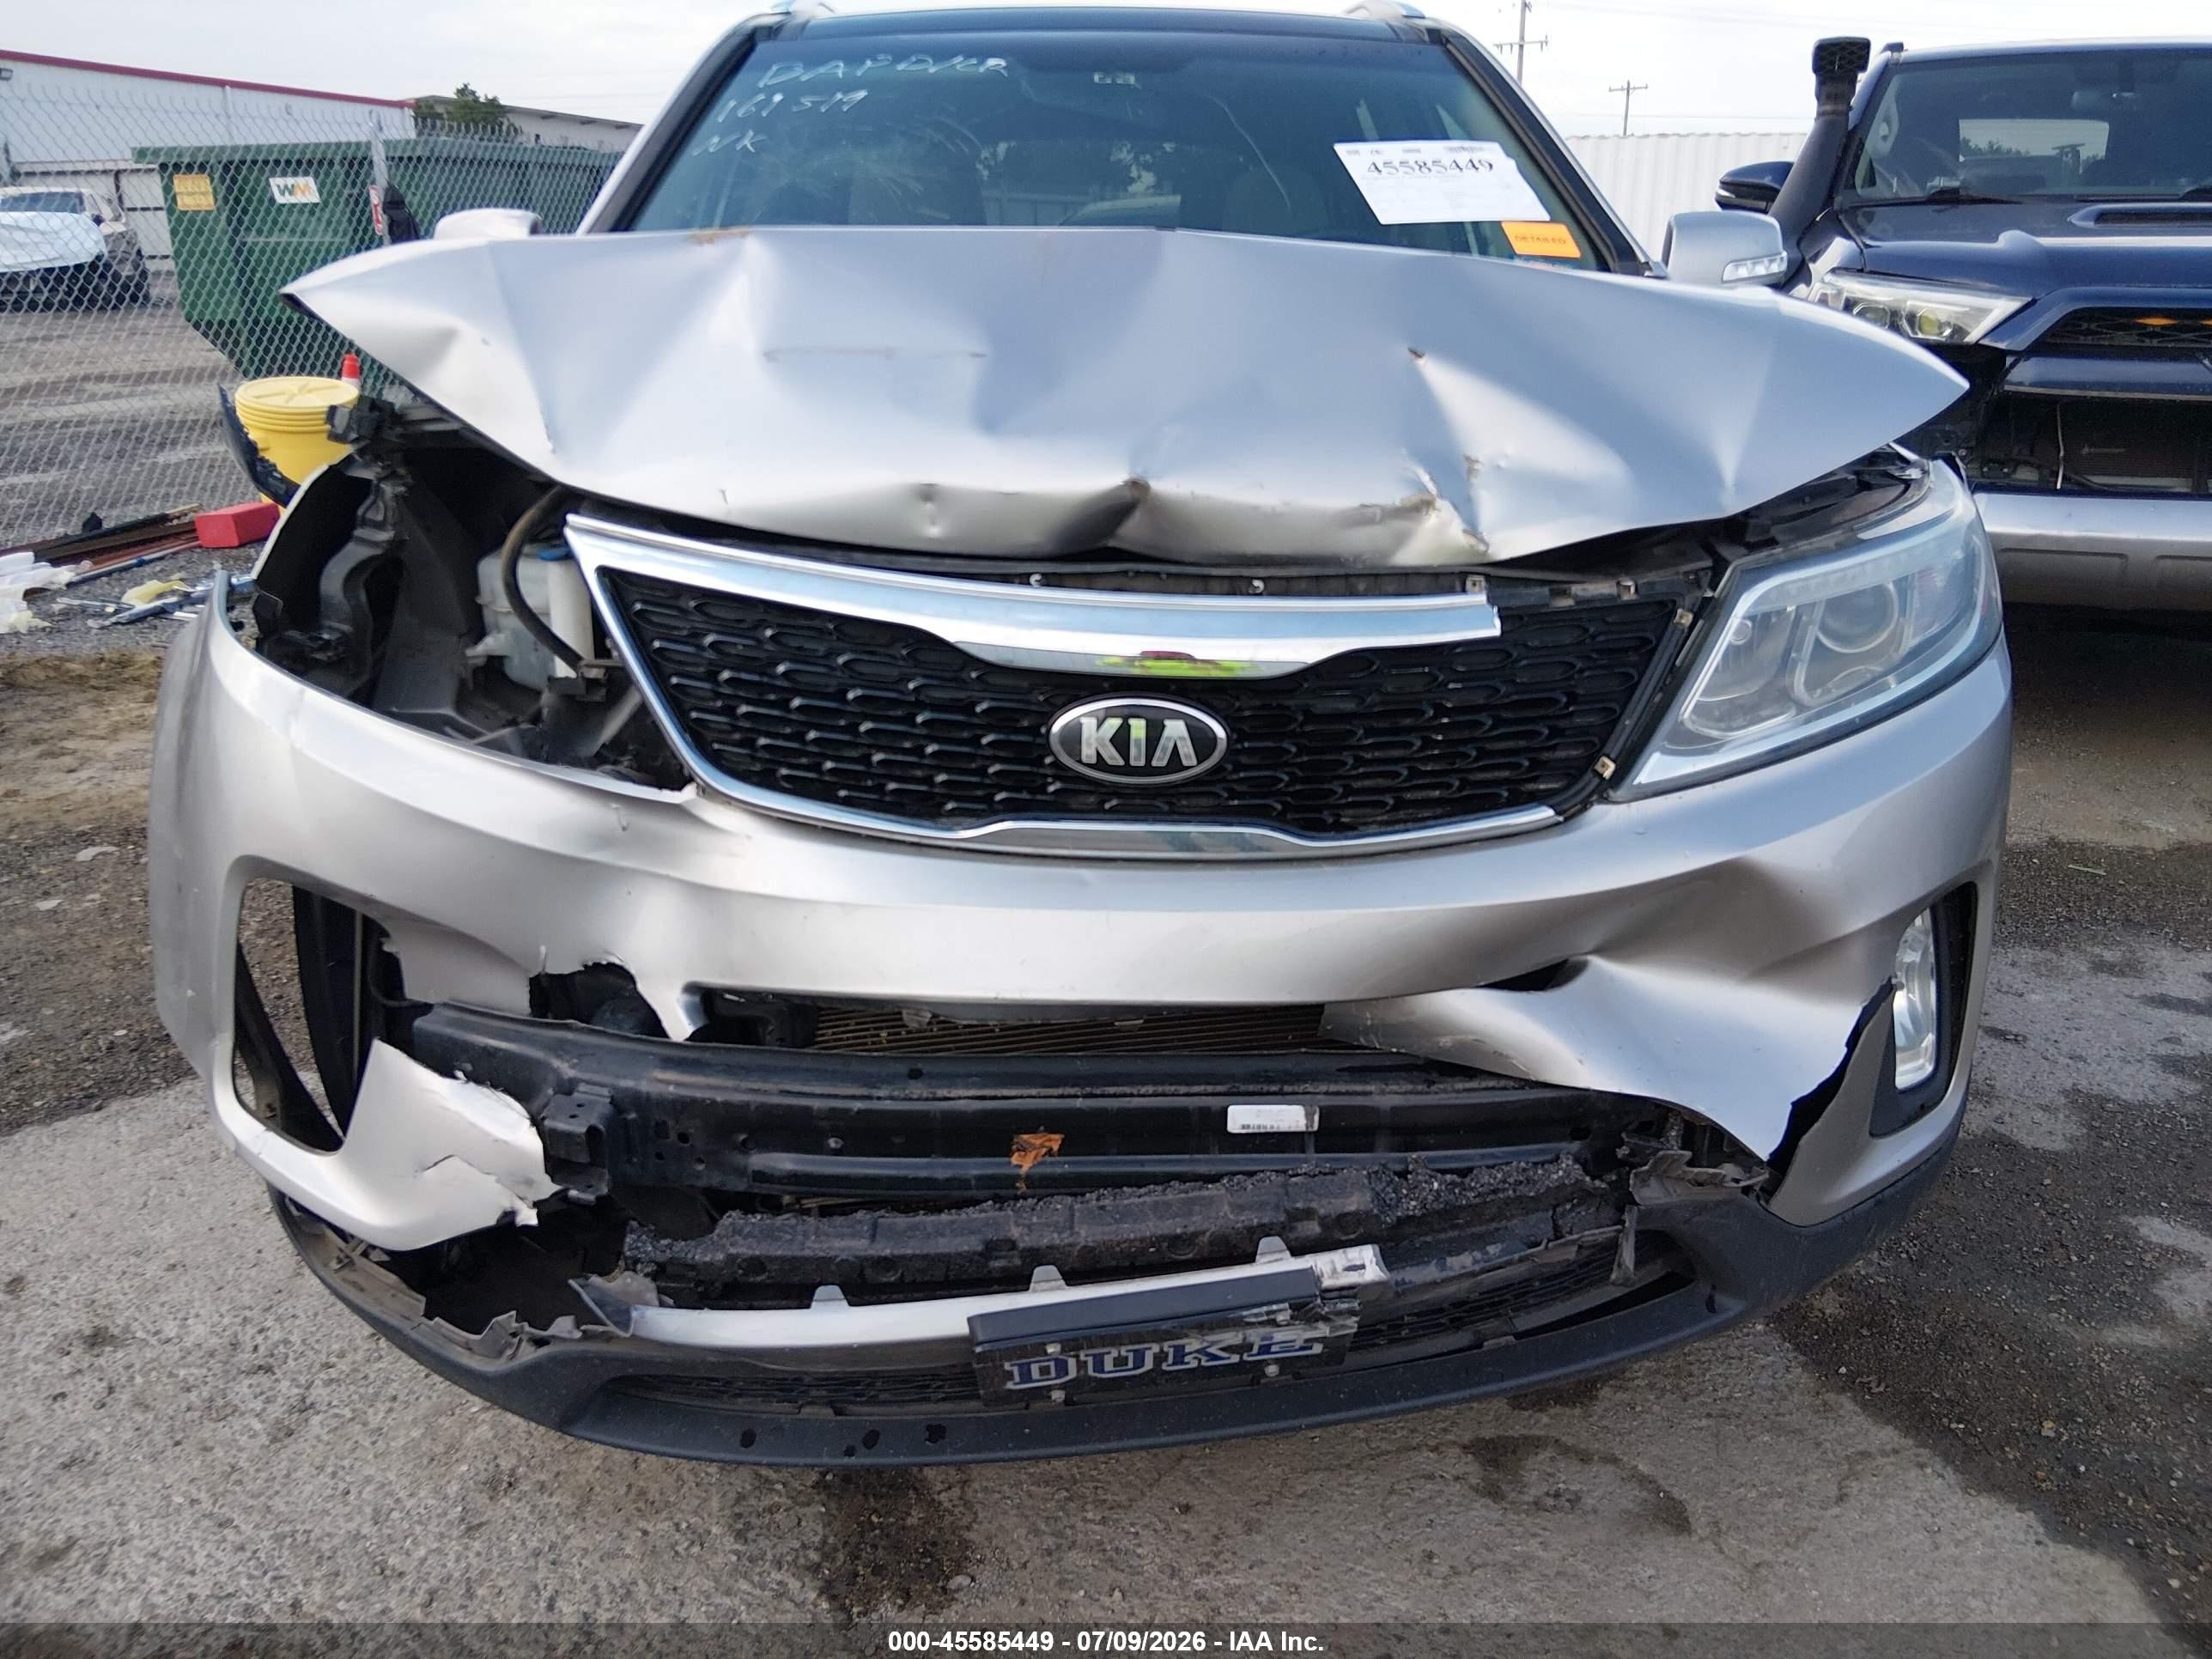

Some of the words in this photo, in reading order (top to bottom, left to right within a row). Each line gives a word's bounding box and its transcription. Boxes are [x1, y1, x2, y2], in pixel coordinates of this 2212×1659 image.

[1367, 158, 1494, 176] 45585449
[276, 182, 312, 197] WM
[1079, 716, 1199, 767] KIA
[1005, 1334, 1323, 1389] DUKE
